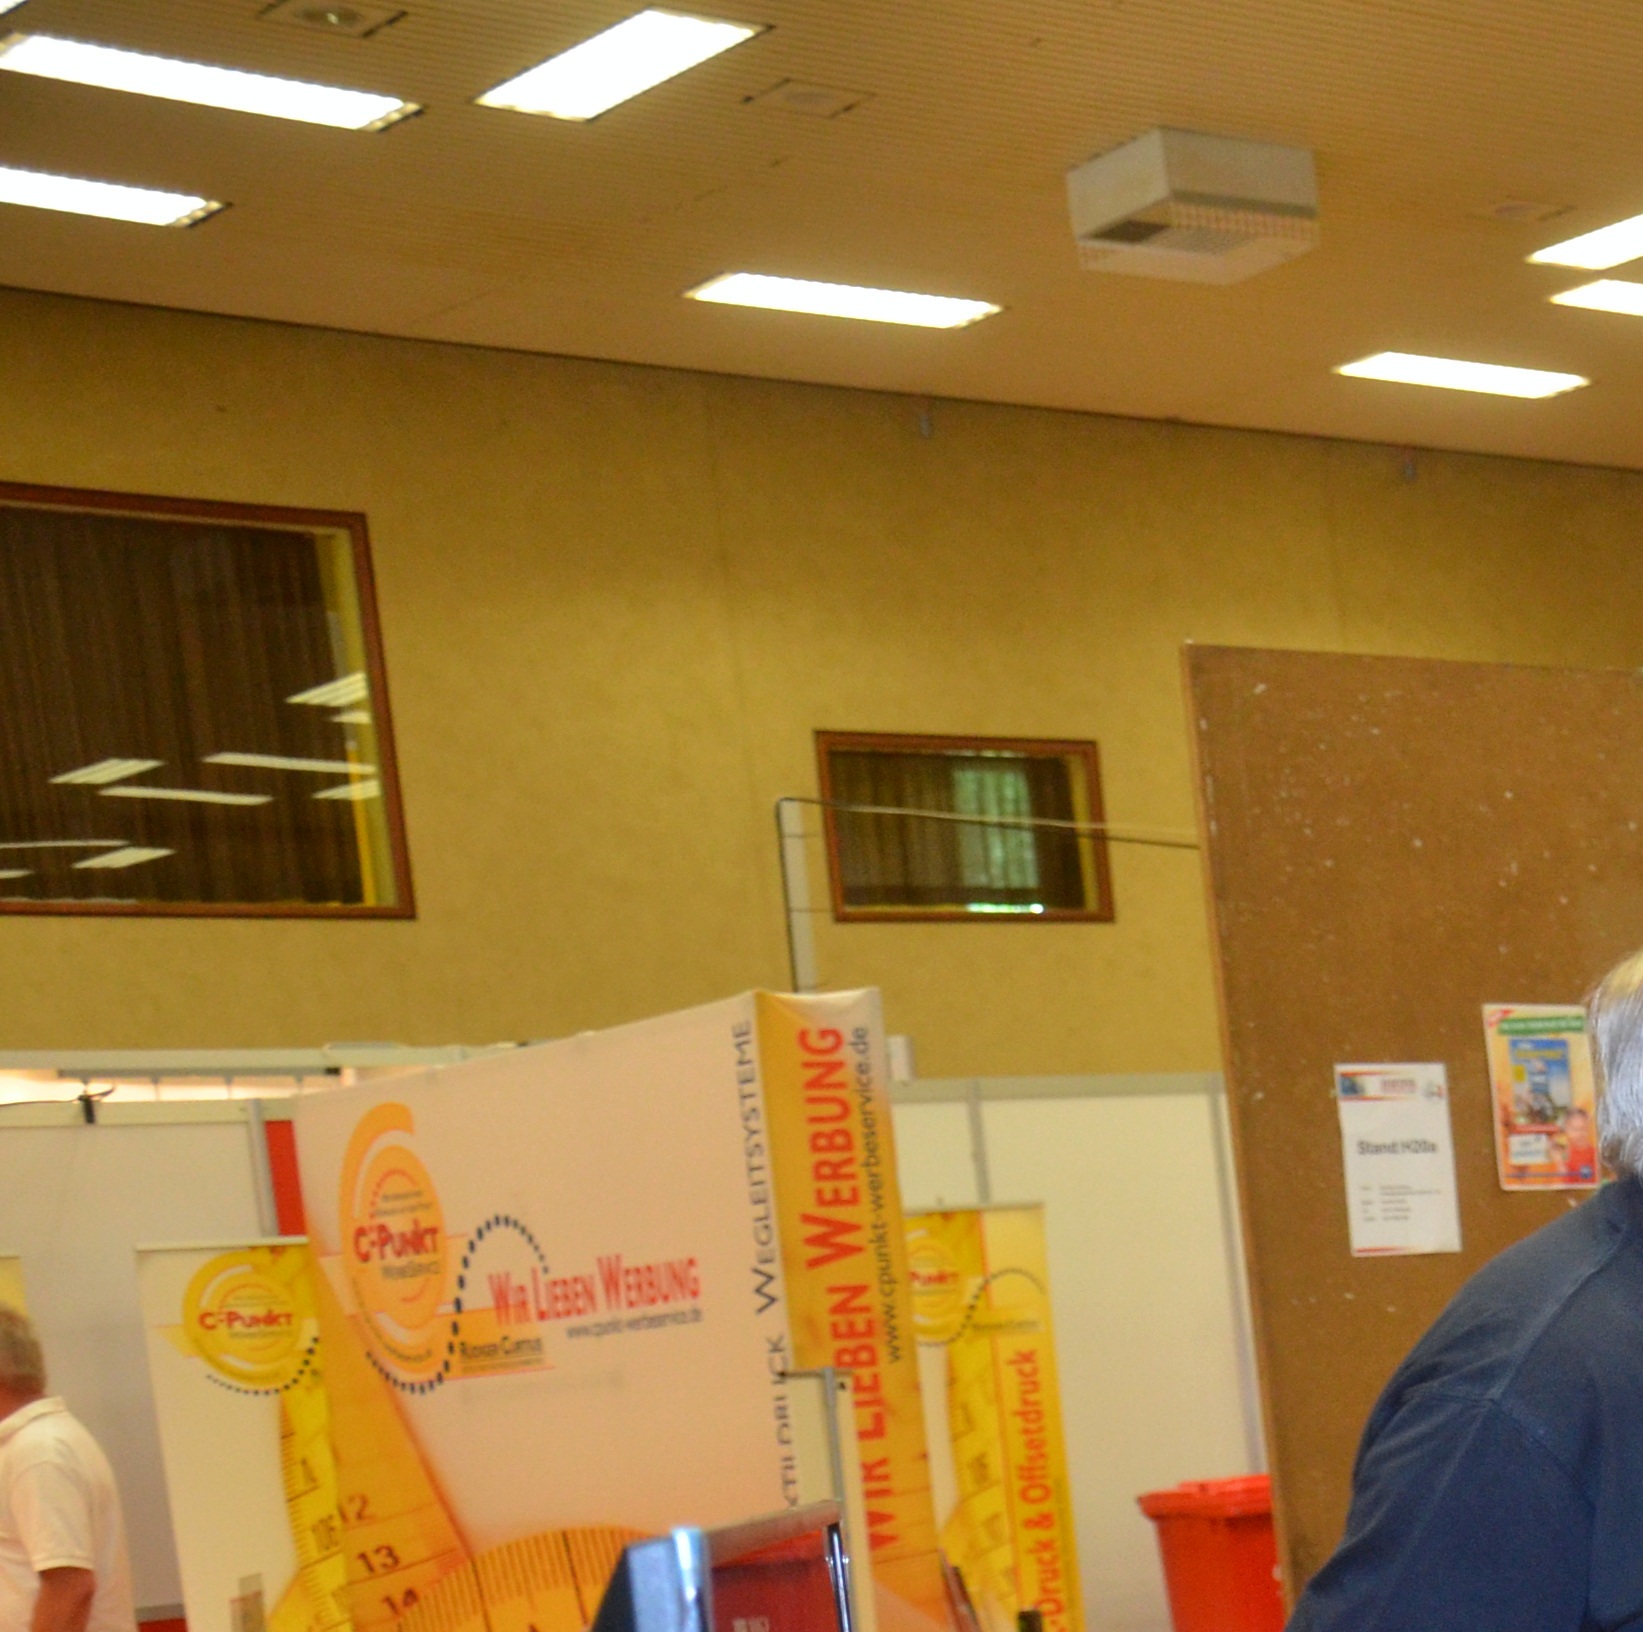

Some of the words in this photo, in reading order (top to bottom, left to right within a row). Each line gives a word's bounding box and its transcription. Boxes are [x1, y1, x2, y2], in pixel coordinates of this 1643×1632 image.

[732, 1018, 780, 1318] WEGLEITSYSTEME
[797, 1024, 869, 1270] WERBUNG
[848, 1026, 902, 1365] www.cpunkt-werbeservice.de
[488, 1271, 531, 1325] WIR
[530, 1265, 598, 1323] LIEBEN
[597, 1252, 700, 1312] WERBUNG
[1006, 1348, 1052, 1504] Offsetdruck
[357, 1544, 400, 1574] 13
[1023, 1512, 1054, 1532] &
